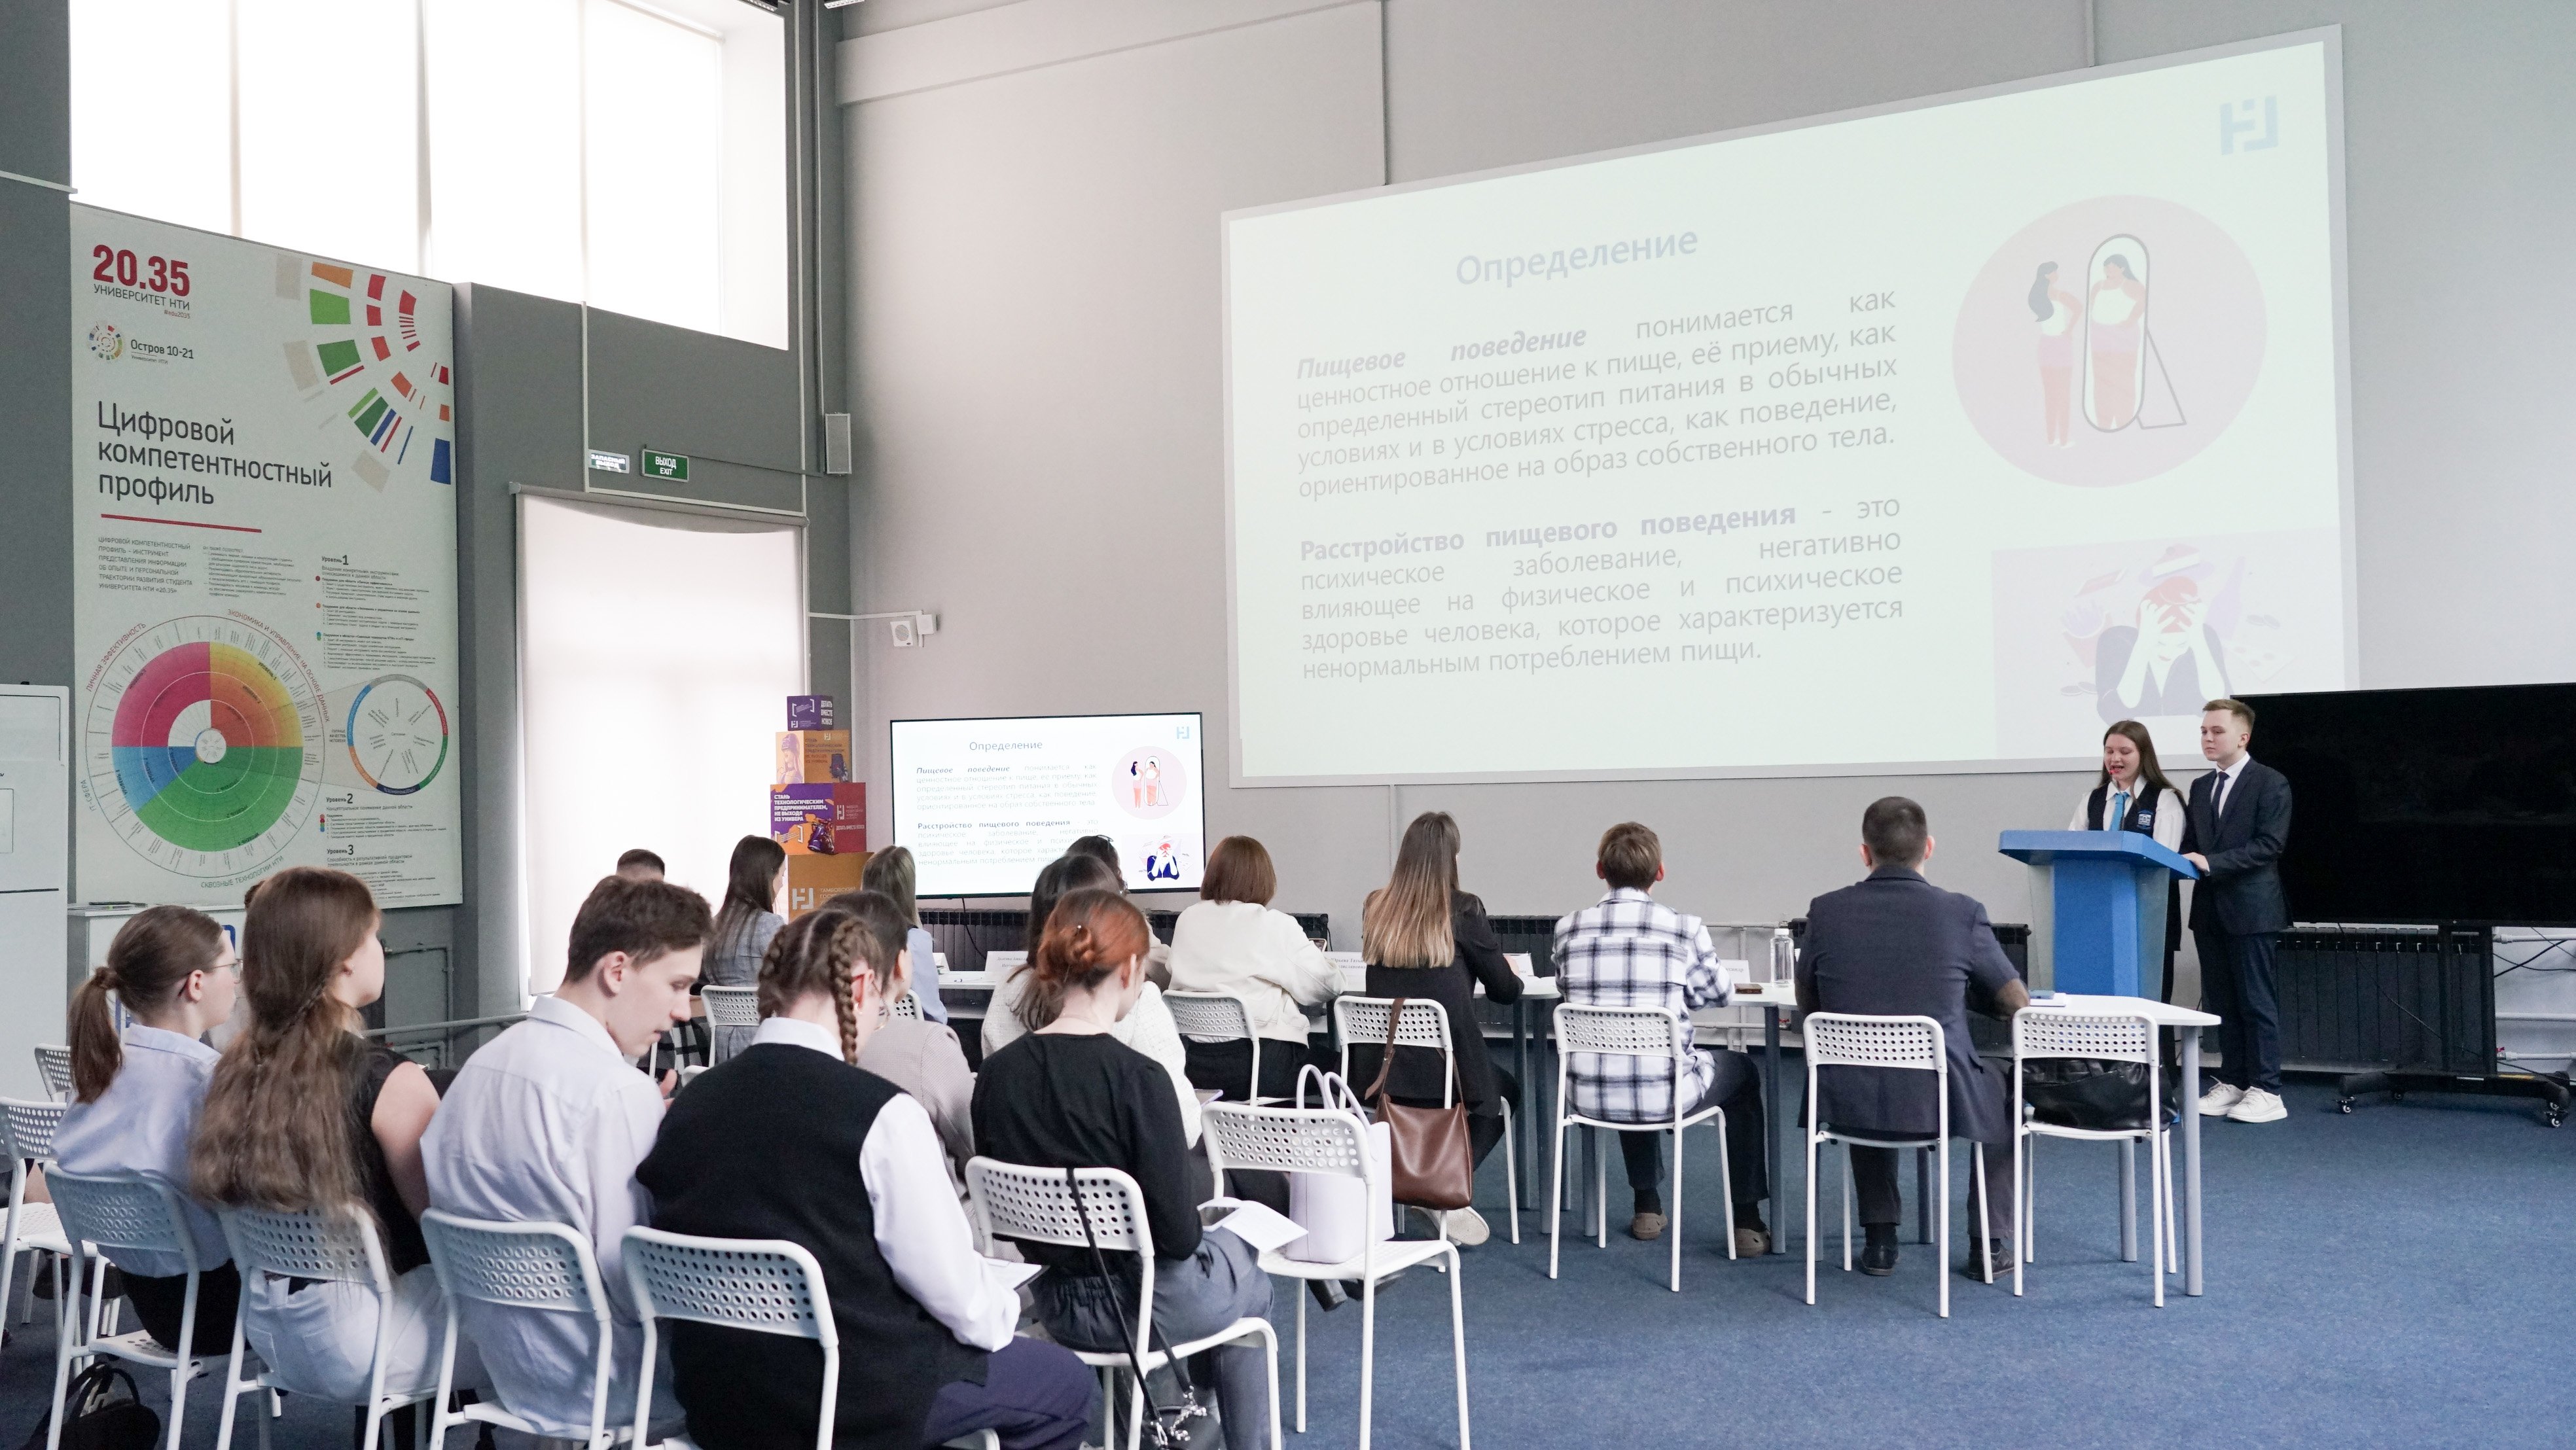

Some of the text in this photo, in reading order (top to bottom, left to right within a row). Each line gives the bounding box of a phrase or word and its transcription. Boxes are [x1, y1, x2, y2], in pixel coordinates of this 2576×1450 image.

[94, 245, 190, 296] 20.35
[1457, 231, 1698, 288] Определение
[94, 283, 190, 310] УНИВЕРСИТЕТ НТИ
[164, 309, 190, 319] #edu2035
[131, 340, 194, 359] Остров 10-21
[1297, 290, 1896, 380] Пищевое поведение понимается как
[1298, 325, 1896, 410] ценностное отношение к пище, её приему, как
[1298, 357, 1897, 442] определенный стереотип питания в обычных
[99, 400, 234, 446] Цифровой
[1298, 393, 1897, 474] условиях и в условиях стресса, как поведение,
[99, 441, 332, 488] компетентностный
[591, 454, 625, 464] ЗАПАСНЫЙ
[655, 456, 676, 469] ВЫХОД
[1299, 424, 1895, 501] ориентированное на образ собственного тела.
[99, 472, 214, 504] профиль
[132, 540, 190, 550] КОМПЕТЕНТНОСТНЫЙ
[1301, 499, 1900, 563] Расстройство пищевого поведения это
[343, 555, 349, 565] 1
[1301, 531, 1901, 598] психическое заболевание, негативно
[1302, 565, 1902, 624] влияющее на физическое и психическое
[1302, 601, 1903, 656] здоровье человека, которое характеризуется
[86, 664, 103, 692] ЛИЧНАЯ
[101, 623, 146, 665] ЭФФЕКТИВНОСТЬ
[228, 609, 263, 628] ЭКОНОМИКА
[270, 629, 302, 661] УПРАВЛЕНИЕ
[300, 660, 308, 669] НА
[306, 669, 321, 693] ОСНОВЕ
[317, 694, 330, 722] ДАННЫХ
[1303, 641, 1761, 682] ненормальным потреблением пищи.
[969, 742, 1043, 752] Определение
[347, 794, 353, 804] 2
[201, 856, 284, 888] СКВОЗНЫЕ ТЕХНОЛОГИИ НТИ
[348, 845, 353, 855] 3
